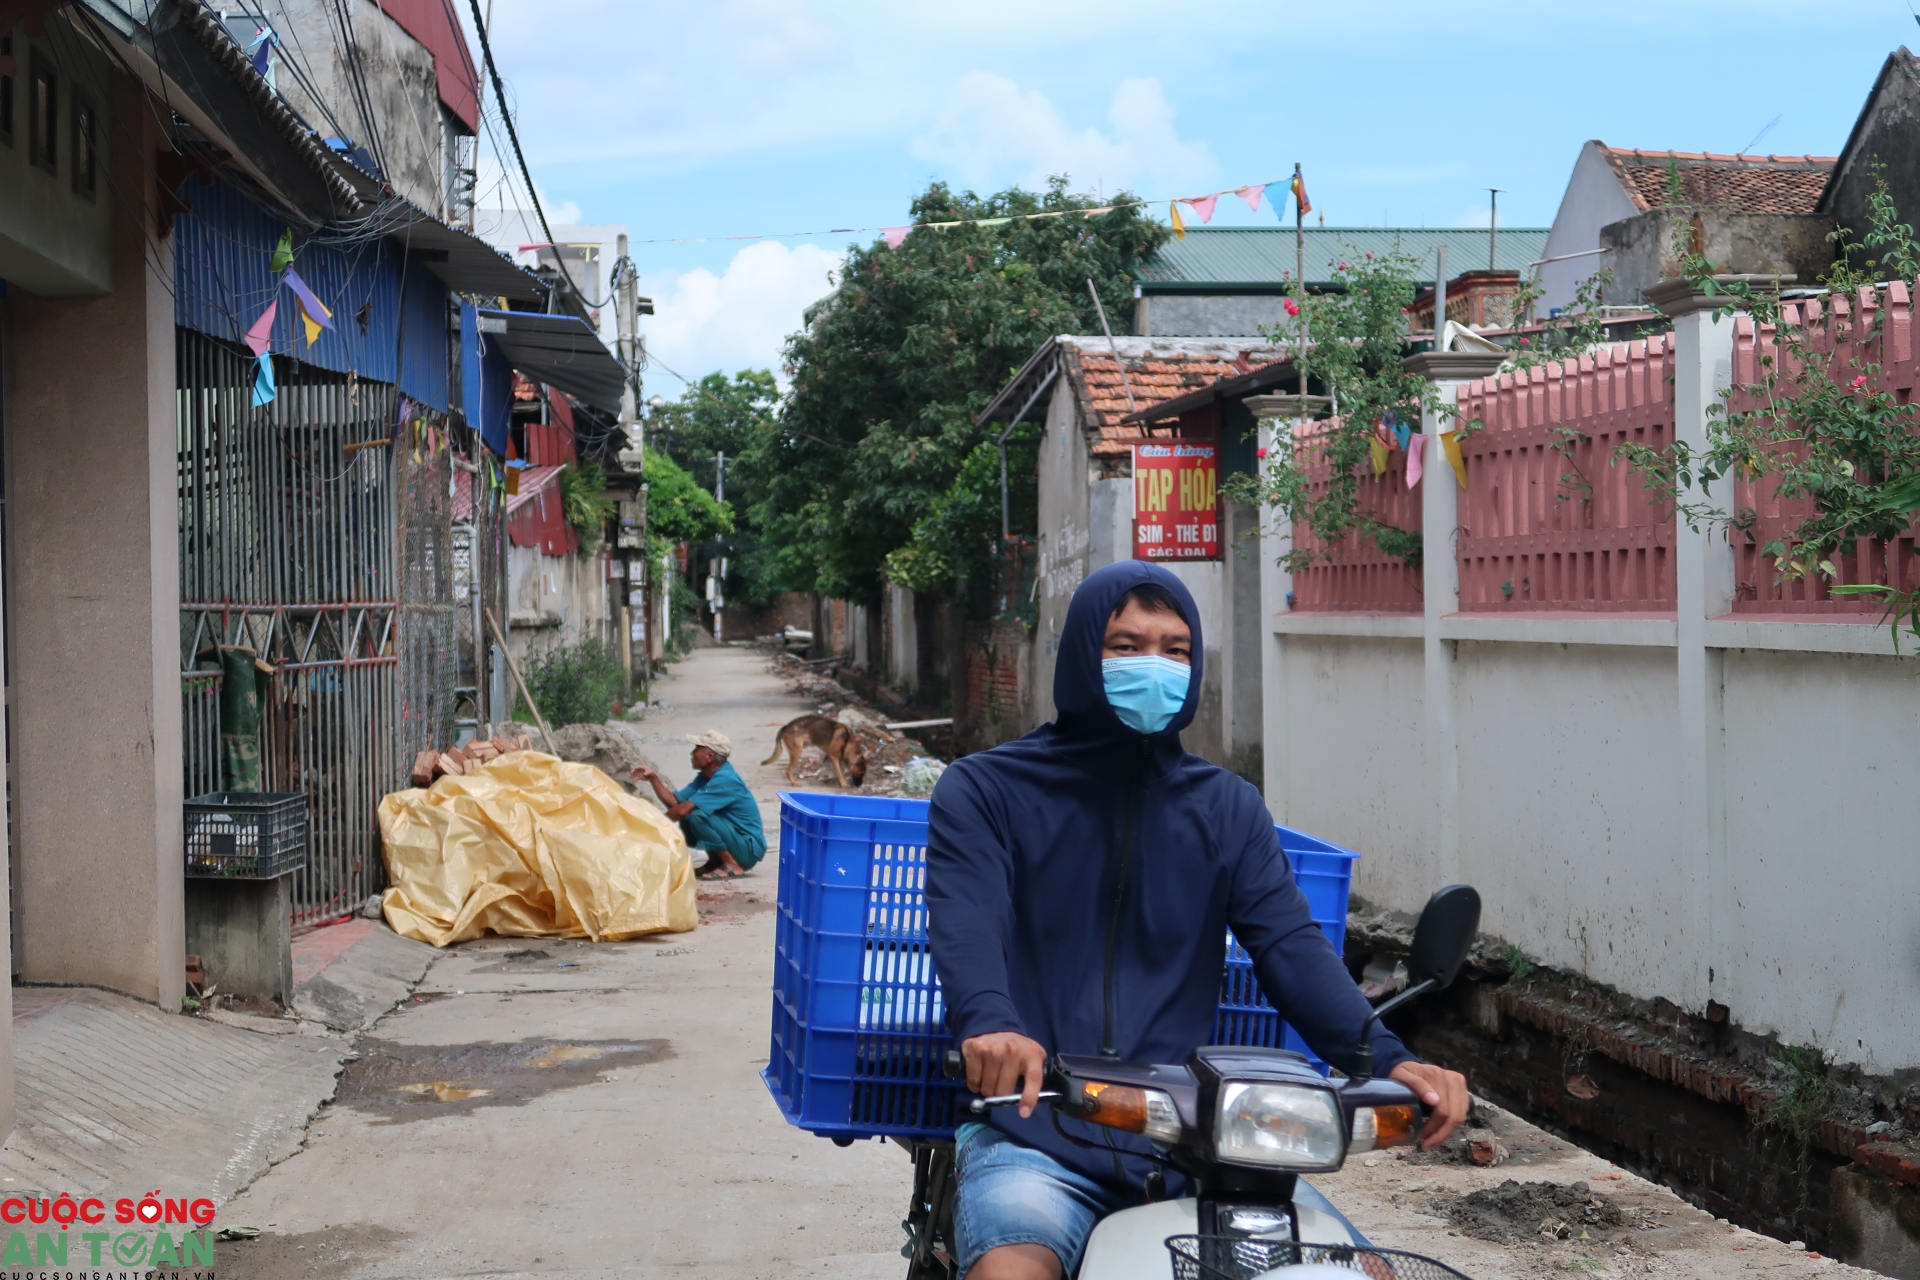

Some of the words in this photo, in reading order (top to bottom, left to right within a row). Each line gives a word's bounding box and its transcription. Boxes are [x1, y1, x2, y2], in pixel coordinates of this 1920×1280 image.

[1174, 444, 1214, 458] hàng
[1137, 468, 1174, 522] TẠP
[1179, 459, 1216, 511] HÓA
[1138, 525, 1163, 543] SIM
[1175, 516, 1199, 543] THẺ
[1147, 547, 1173, 557] CÁC
